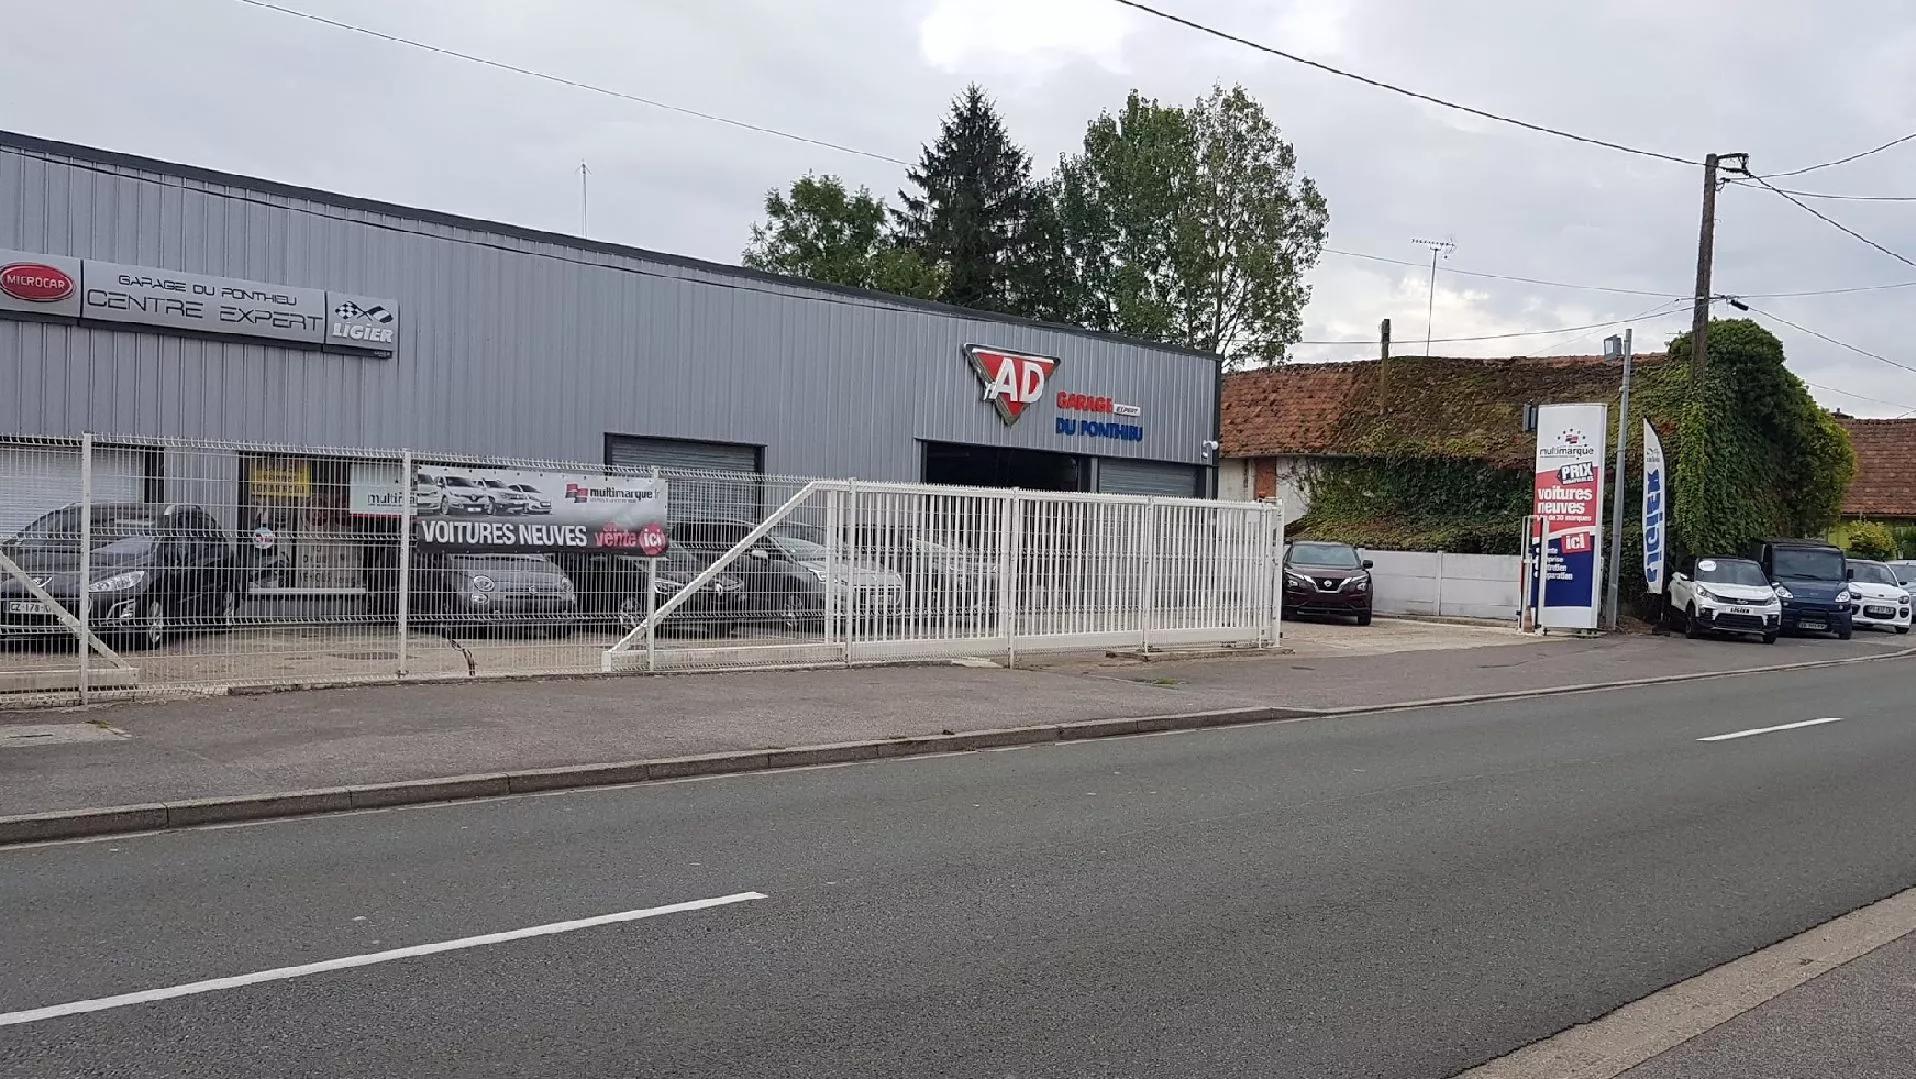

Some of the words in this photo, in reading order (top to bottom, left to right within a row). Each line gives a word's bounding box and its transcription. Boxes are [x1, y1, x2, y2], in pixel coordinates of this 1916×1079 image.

[7, 274, 66, 289] MICROCAR
[119, 275, 187, 292] GARAGE
[193, 284, 215, 296] DU
[222, 287, 298, 306] PONTHIEU
[87, 289, 204, 319] CENTRE
[219, 305, 323, 332] EXPERT
[989, 357, 1045, 403] AD
[1056, 391, 1112, 414] GARAGE
[1055, 417, 1076, 436] DU
[1079, 420, 1143, 442] PONTHIEU
[1539, 447, 1594, 456] multimarque
[1561, 462, 1593, 478] PRIX
[1537, 486, 1592, 501] voitures
[1537, 502, 1585, 515] neuves
[421, 520, 516, 545] VOITURES
[519, 523, 587, 548] NEUVES
[643, 527, 662, 547] ici
[1565, 533, 1585, 550] ici
